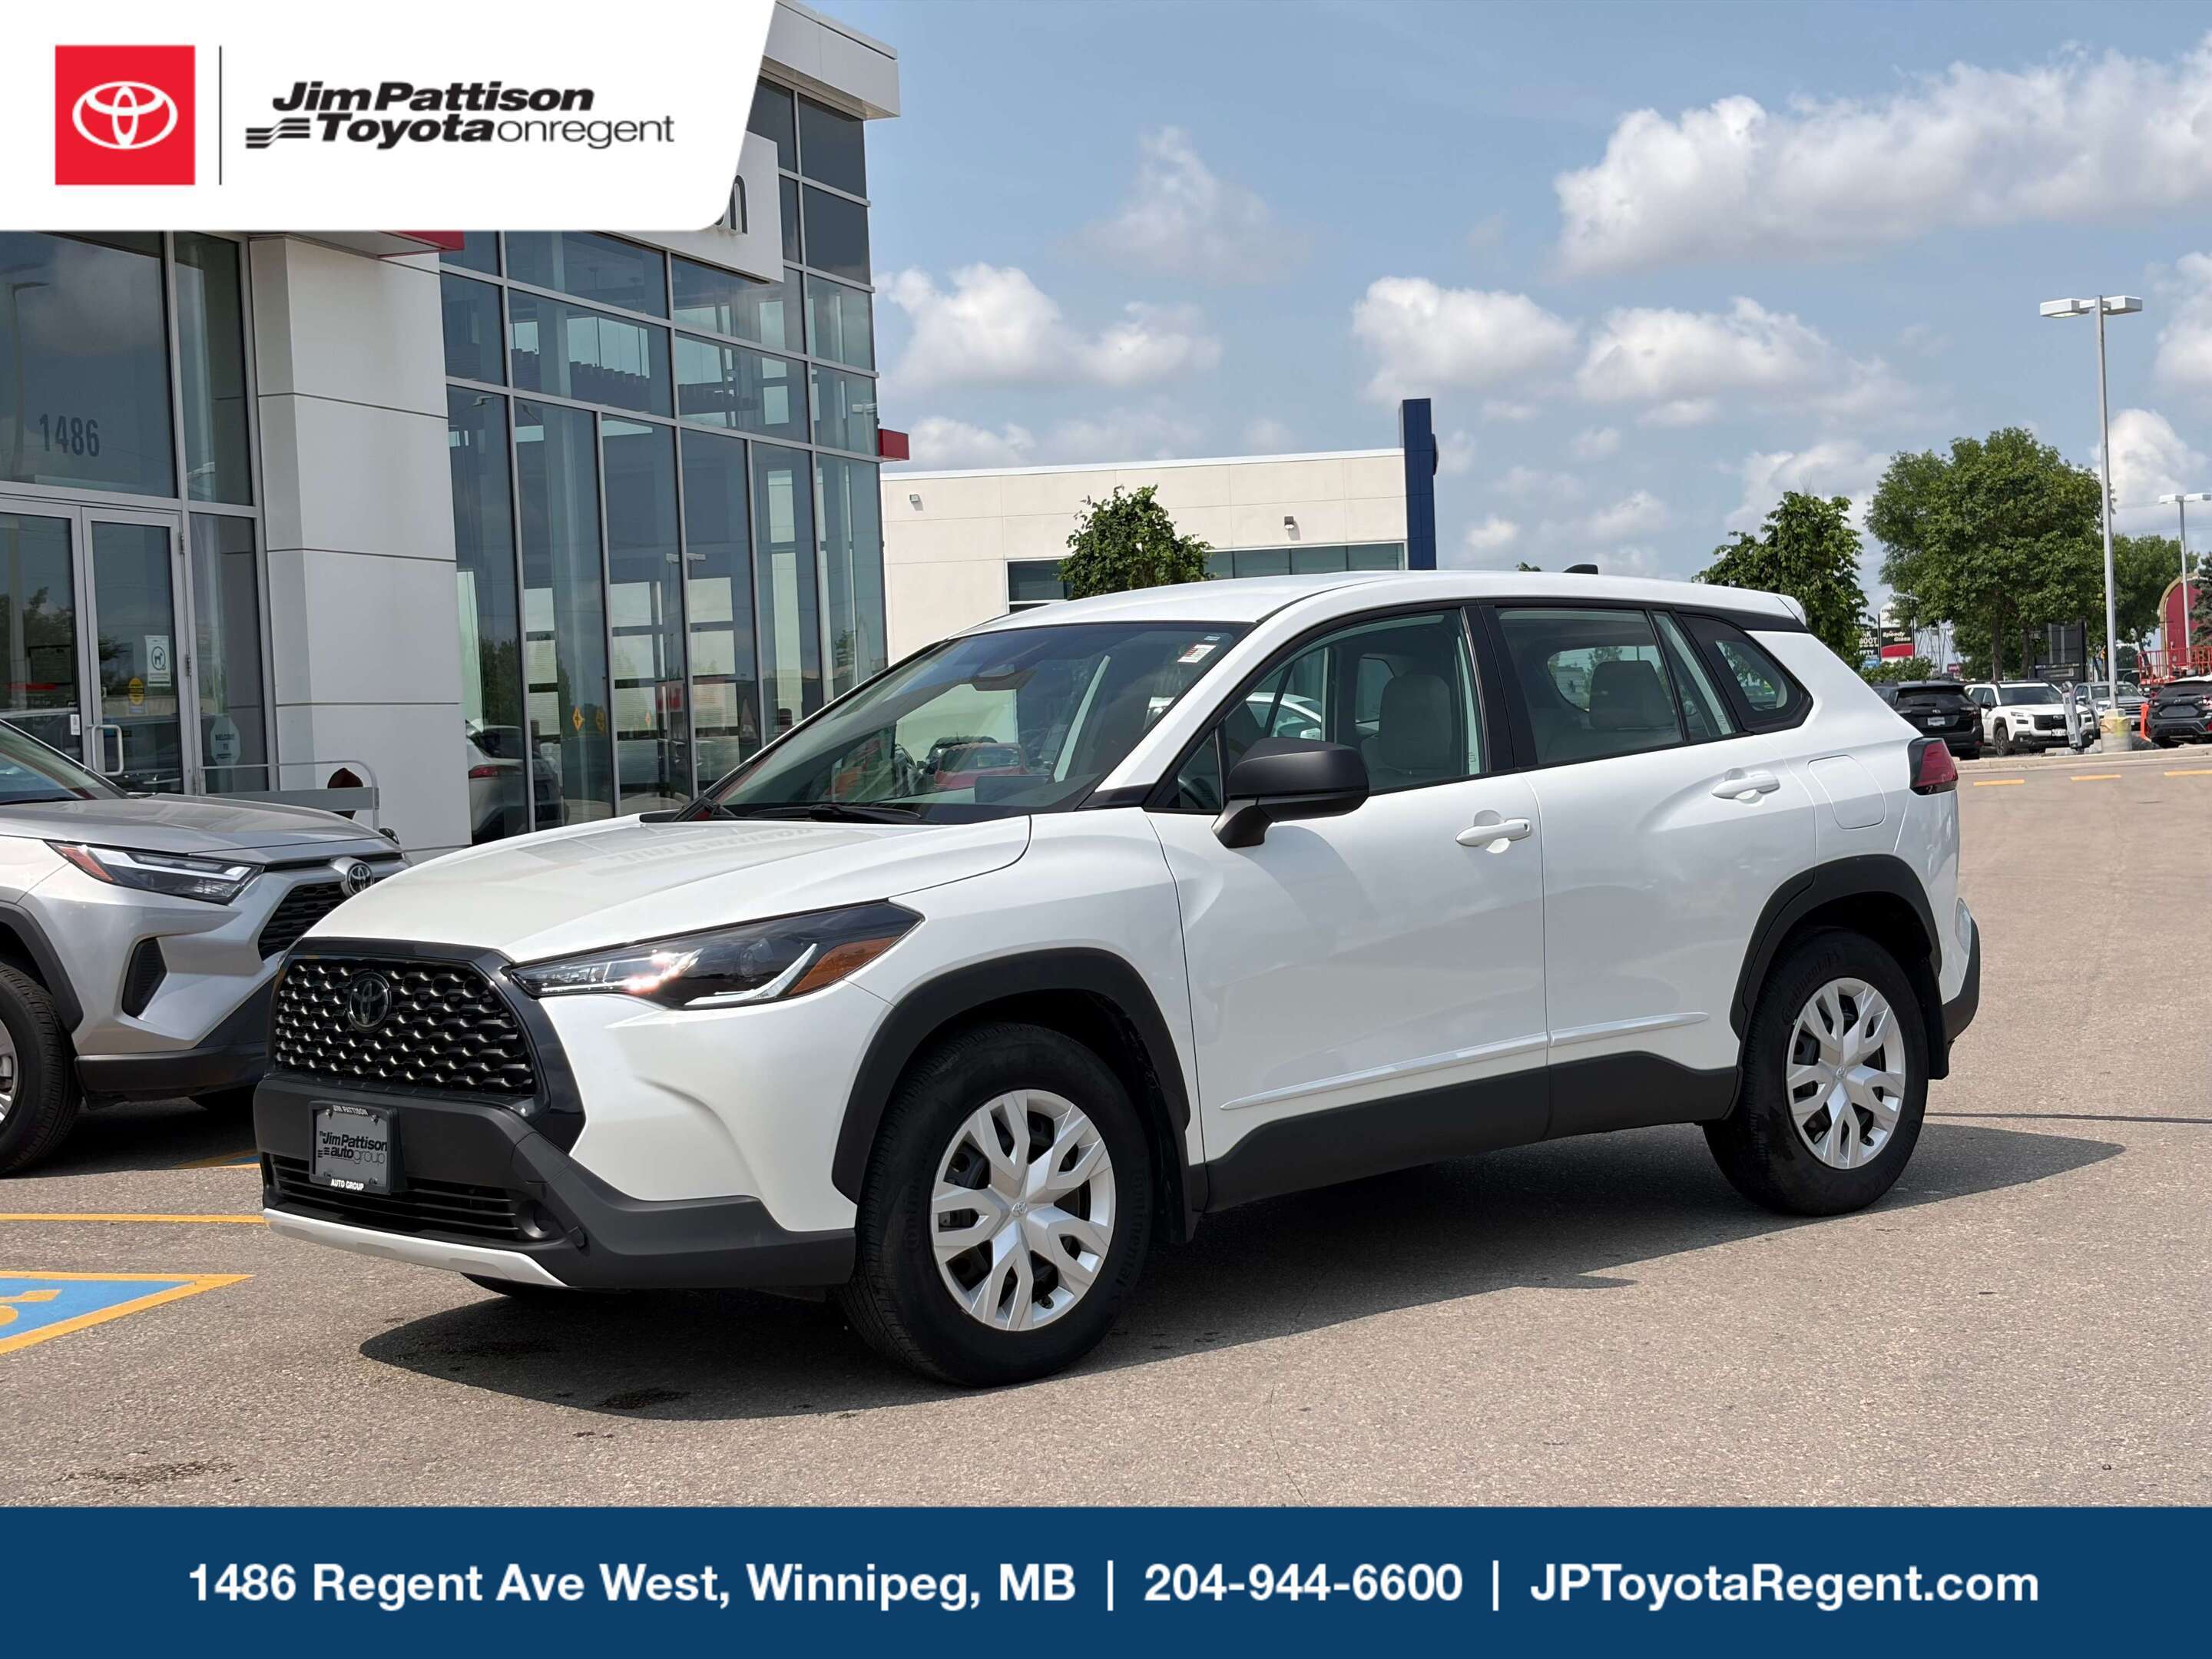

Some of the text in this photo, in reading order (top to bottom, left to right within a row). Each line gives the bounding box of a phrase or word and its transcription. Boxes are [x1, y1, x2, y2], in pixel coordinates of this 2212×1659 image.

[39, 413, 100, 457] 1486
[330, 1178, 365, 1191] AUTO GROUP
